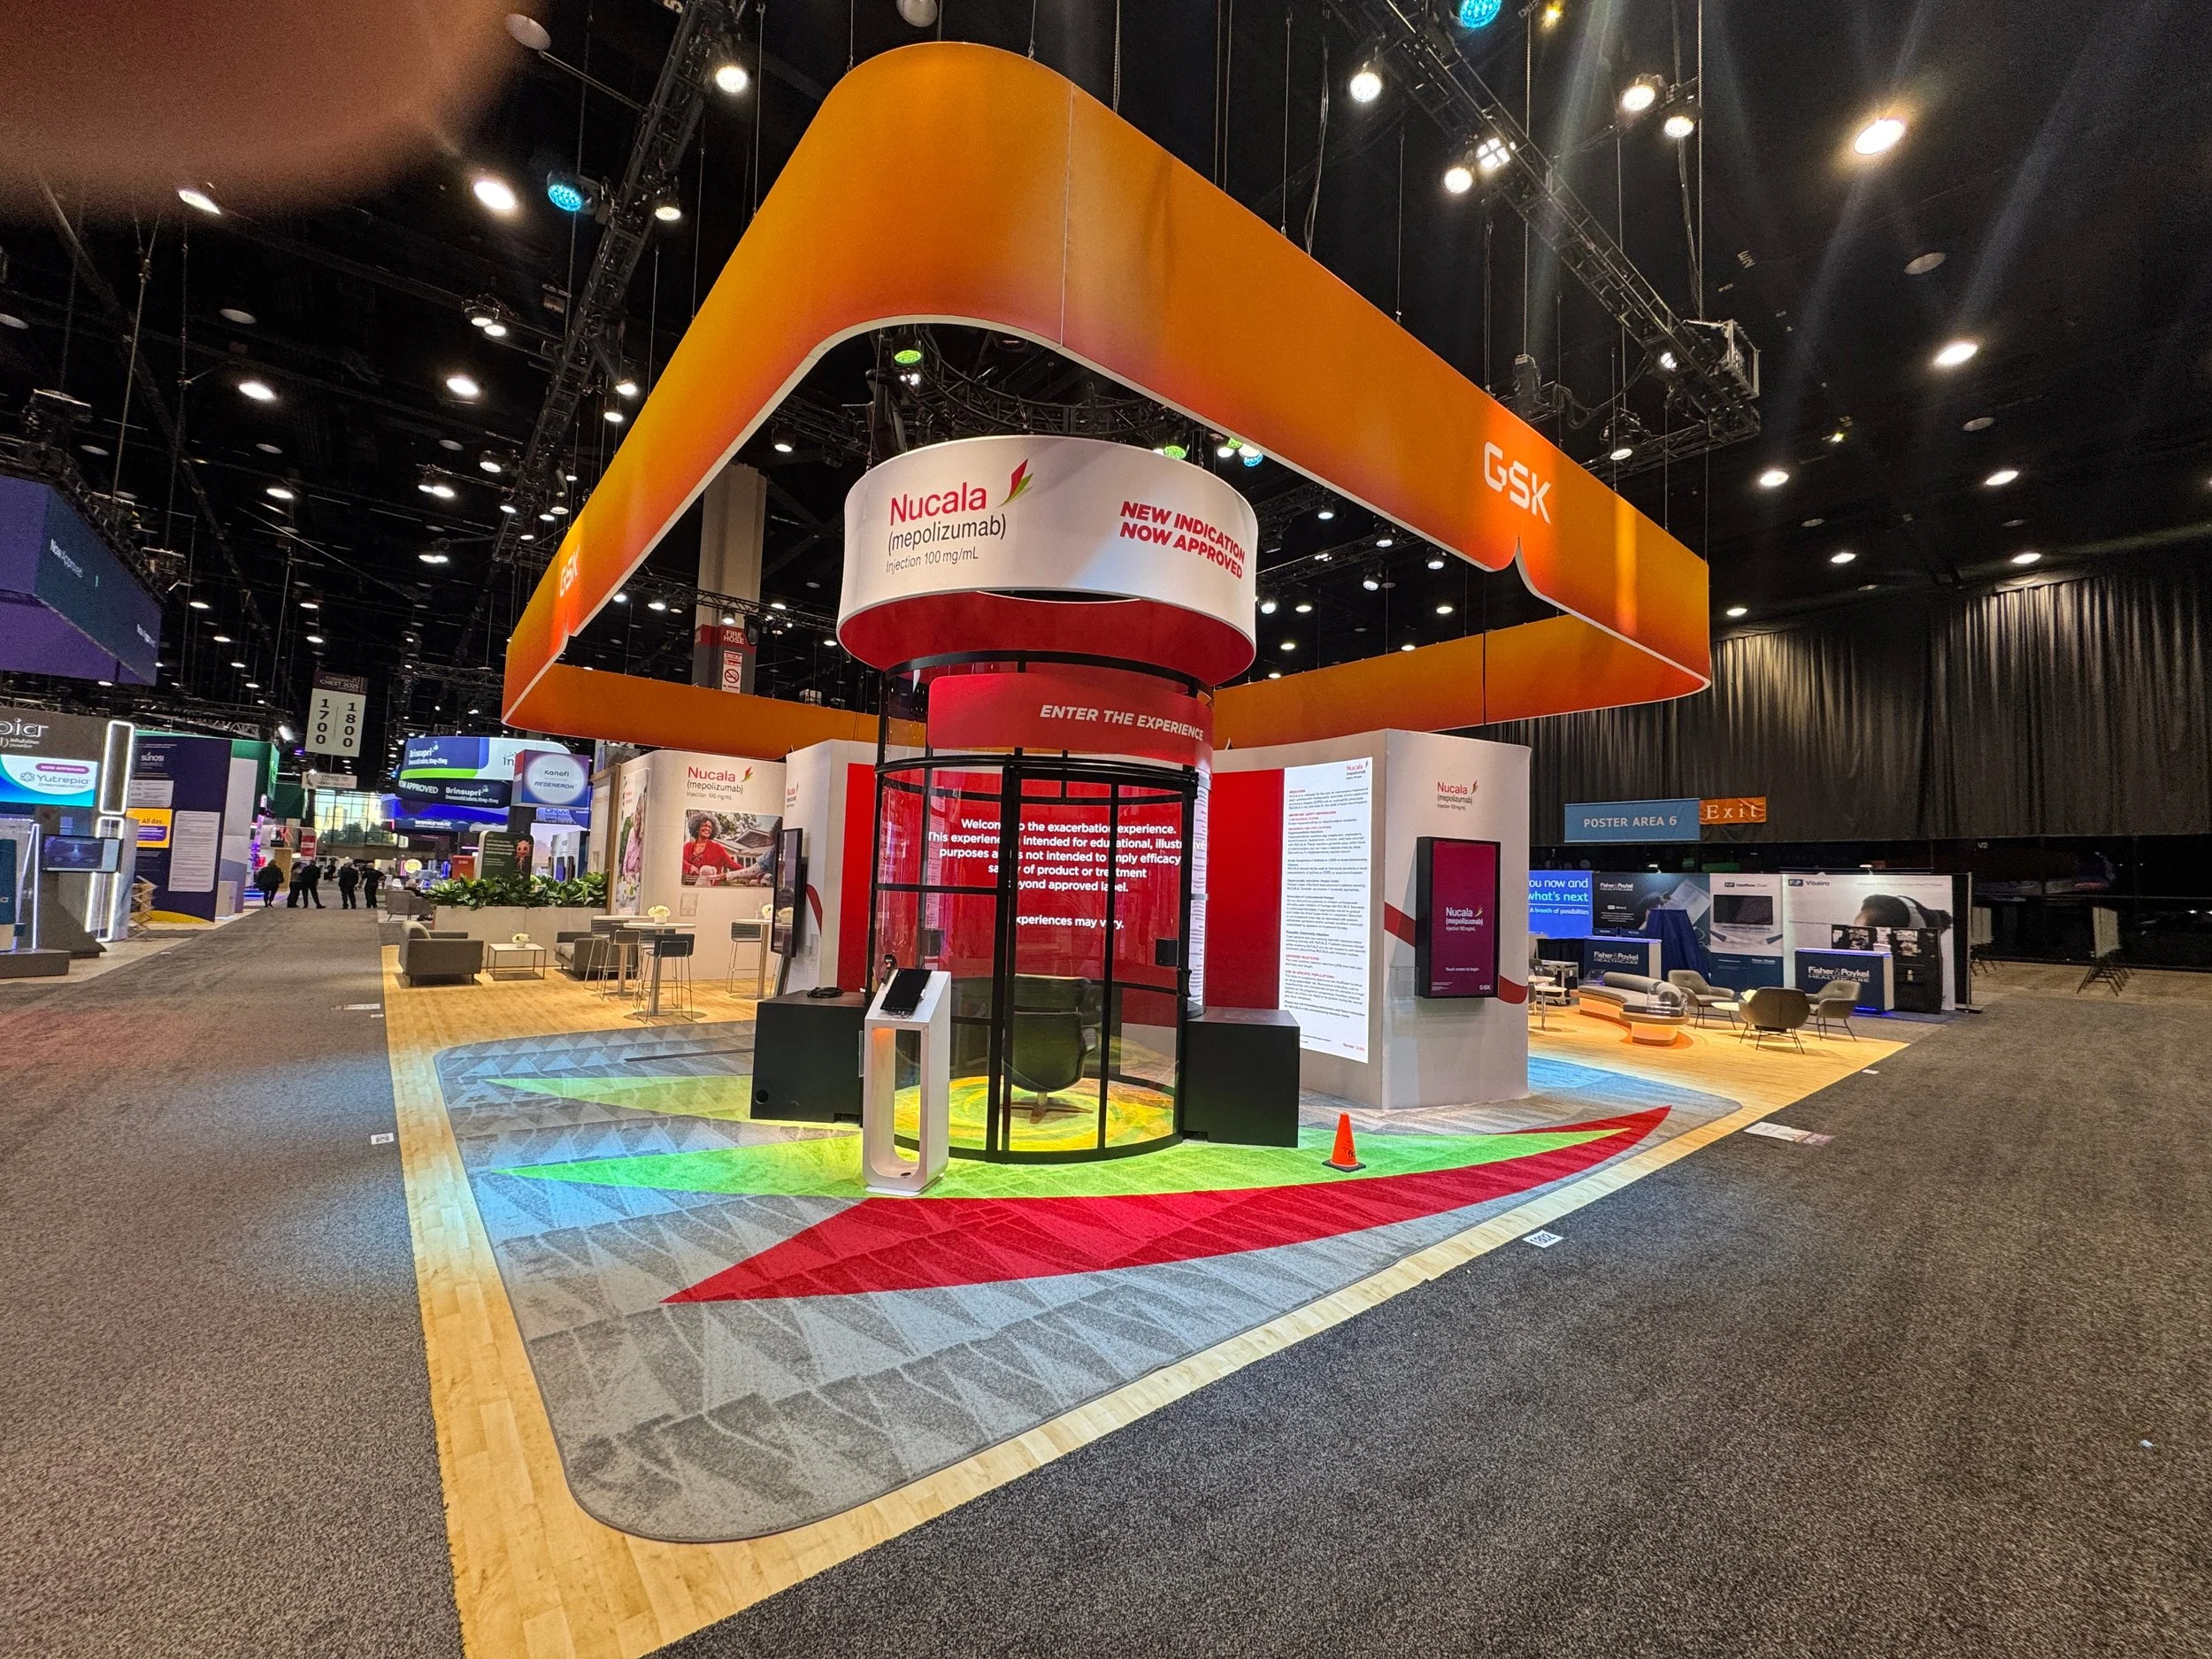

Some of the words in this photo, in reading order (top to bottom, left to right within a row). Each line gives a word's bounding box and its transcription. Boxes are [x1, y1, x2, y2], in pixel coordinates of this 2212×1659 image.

[1484, 441, 1552, 525] GSK
[890, 481, 987, 526] Nucala
[887, 513, 1007, 556] (mepolizumab)
[1119, 501, 1172, 526] NEW
[1173, 513, 1246, 565] INDICATION
[1119, 522, 1172, 546] NOW
[1172, 534, 1243, 580] APPROVED
[886, 554, 921, 574] Injection
[924, 550, 941, 565] 100
[942, 546, 979, 565] mg/mL
[723, 635, 745, 645] HOSE
[726, 629, 742, 638] FIRE
[315, 698, 330, 745] 1700
[342, 702, 357, 748] 1800
[1040, 704, 1099, 722] ENTER
[1103, 710, 1133, 726] THE
[1136, 714, 1204, 741] EXPERIENCE
[36, 774, 88, 785] Yutrepia
[687, 766, 736, 782] Nucala
[406, 781, 439, 794] APPROVED
[445, 787, 481, 797] Brinsupri
[687, 780, 744, 795] (mepolizumab)
[1437, 781, 1468, 795] Nucala
[1707, 803, 1757, 819] Exit
[1027, 821, 1046, 832] the
[1117, 824, 1177, 835] experience.
[1584, 817, 1628, 828] POSTER
[1632, 816, 1665, 827] AREA
[1669, 815, 1678, 826] 6
[1023, 835, 1070, 847] intended
[1072, 837, 1088, 847] for
[1089, 837, 1153, 849] eduational,
[939, 848, 989, 858] purposes
[1025, 851, 1044, 860] not
[1046, 850, 1093, 862] intended
[1094, 852, 1107, 862] to
[1140, 853, 1182, 866] efficacy
[1023, 864, 1035, 874] of
[1037, 865, 1079, 876] product
[1081, 867, 1094, 876] or
[1094, 867, 1148, 878] tretment
[1048, 881, 1098, 892] approved
[1101, 881, 1129, 893] lael.
[1529, 879, 1542, 888] ou
[1544, 879, 1565, 888] now
[1567, 878, 1589, 888] and
[1563, 892, 1589, 902] next
[1445, 906, 1473, 917] Nucala
[1016, 914, 1072, 926] xperiences
[1074, 918, 1097, 929] may
[1808, 966, 1834, 975] Fisher
[1840, 968, 1870, 977] Paykel
